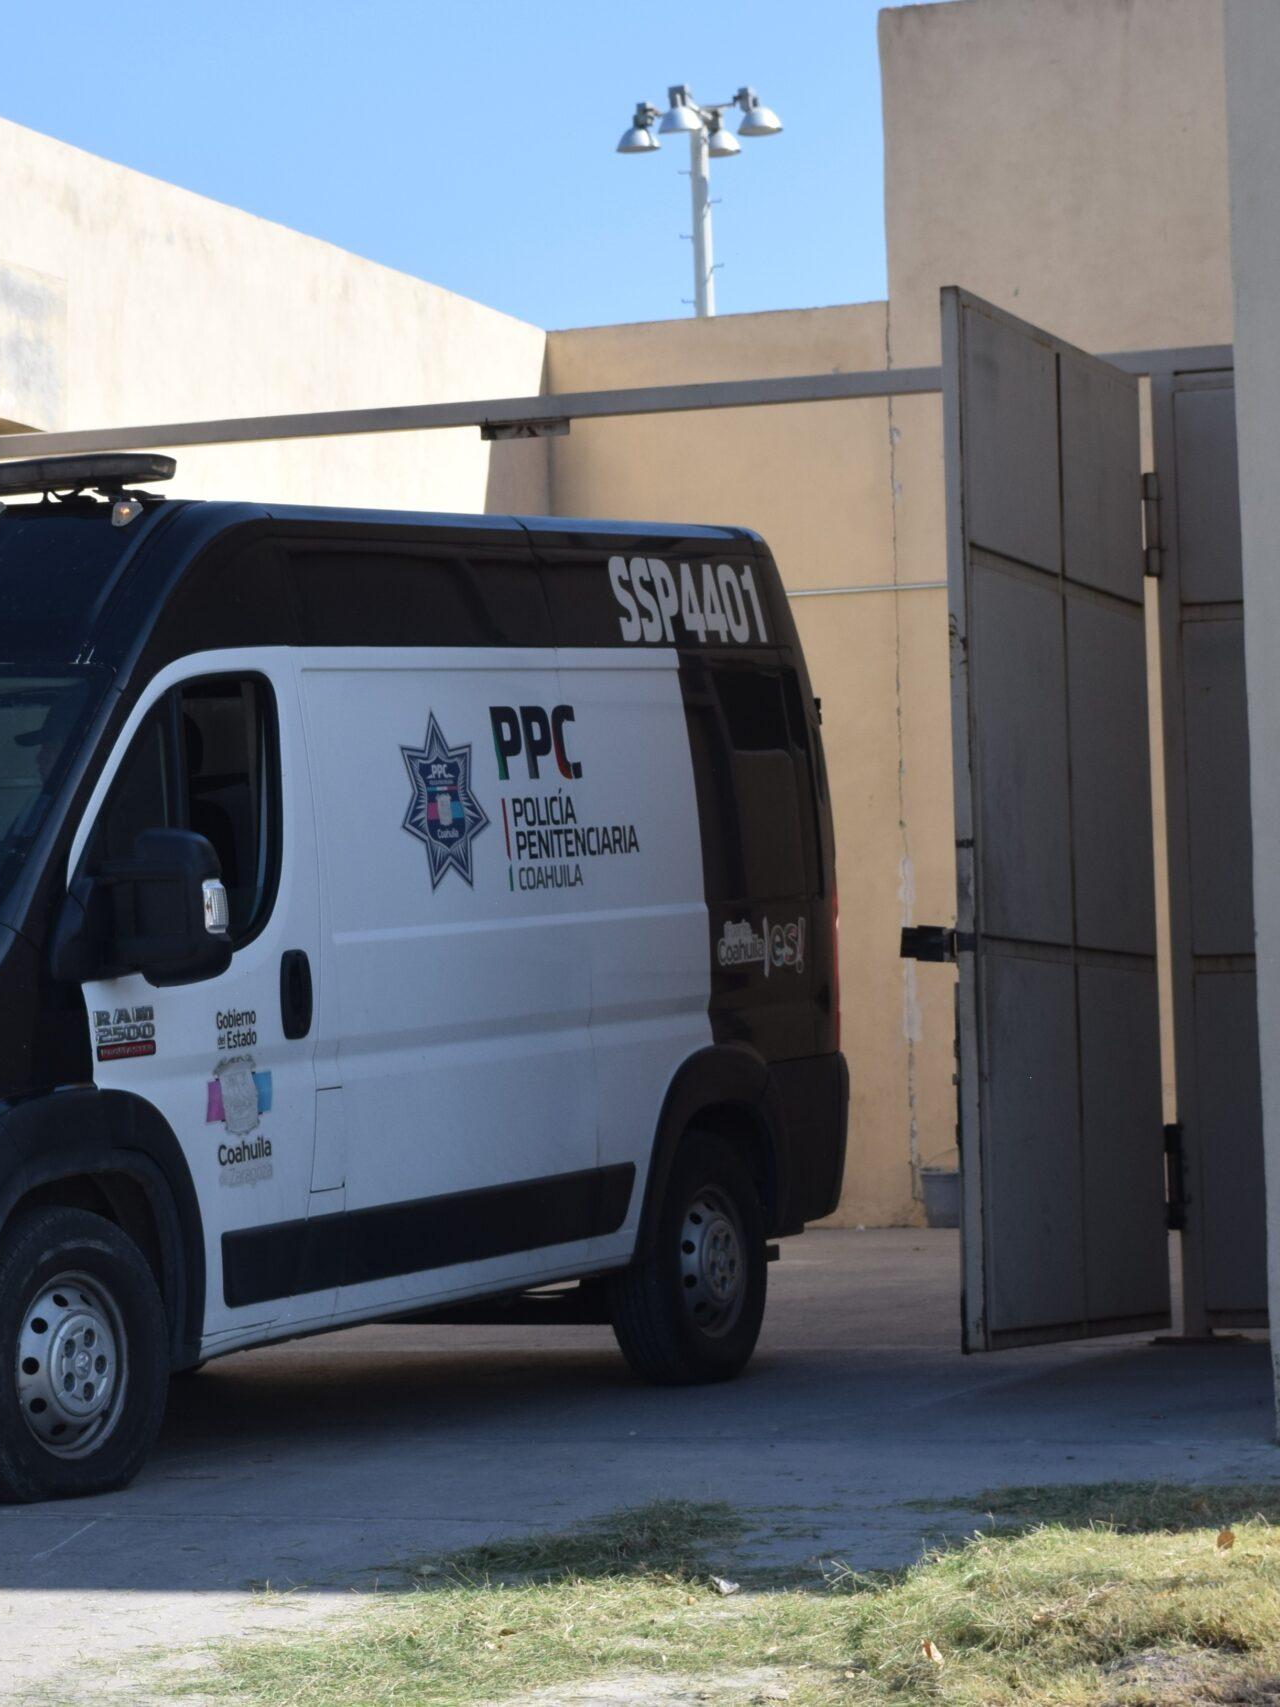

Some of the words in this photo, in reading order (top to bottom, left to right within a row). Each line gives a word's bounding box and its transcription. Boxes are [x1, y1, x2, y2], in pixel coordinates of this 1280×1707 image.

[608, 556, 768, 643] SSP4401
[489, 705, 583, 780] PPC
[431, 764, 449, 778] PPC
[512, 788, 577, 826] POLICÍA
[515, 825, 640, 860] PENITENCIARIA
[519, 863, 584, 891] COAHUILA
[93, 1006, 154, 1027] RAM
[216, 1009, 257, 1030] Gobierno
[95, 1022, 155, 1044] 2500
[227, 1030, 257, 1049] Estado
[218, 1136, 272, 1166] Coahuila
